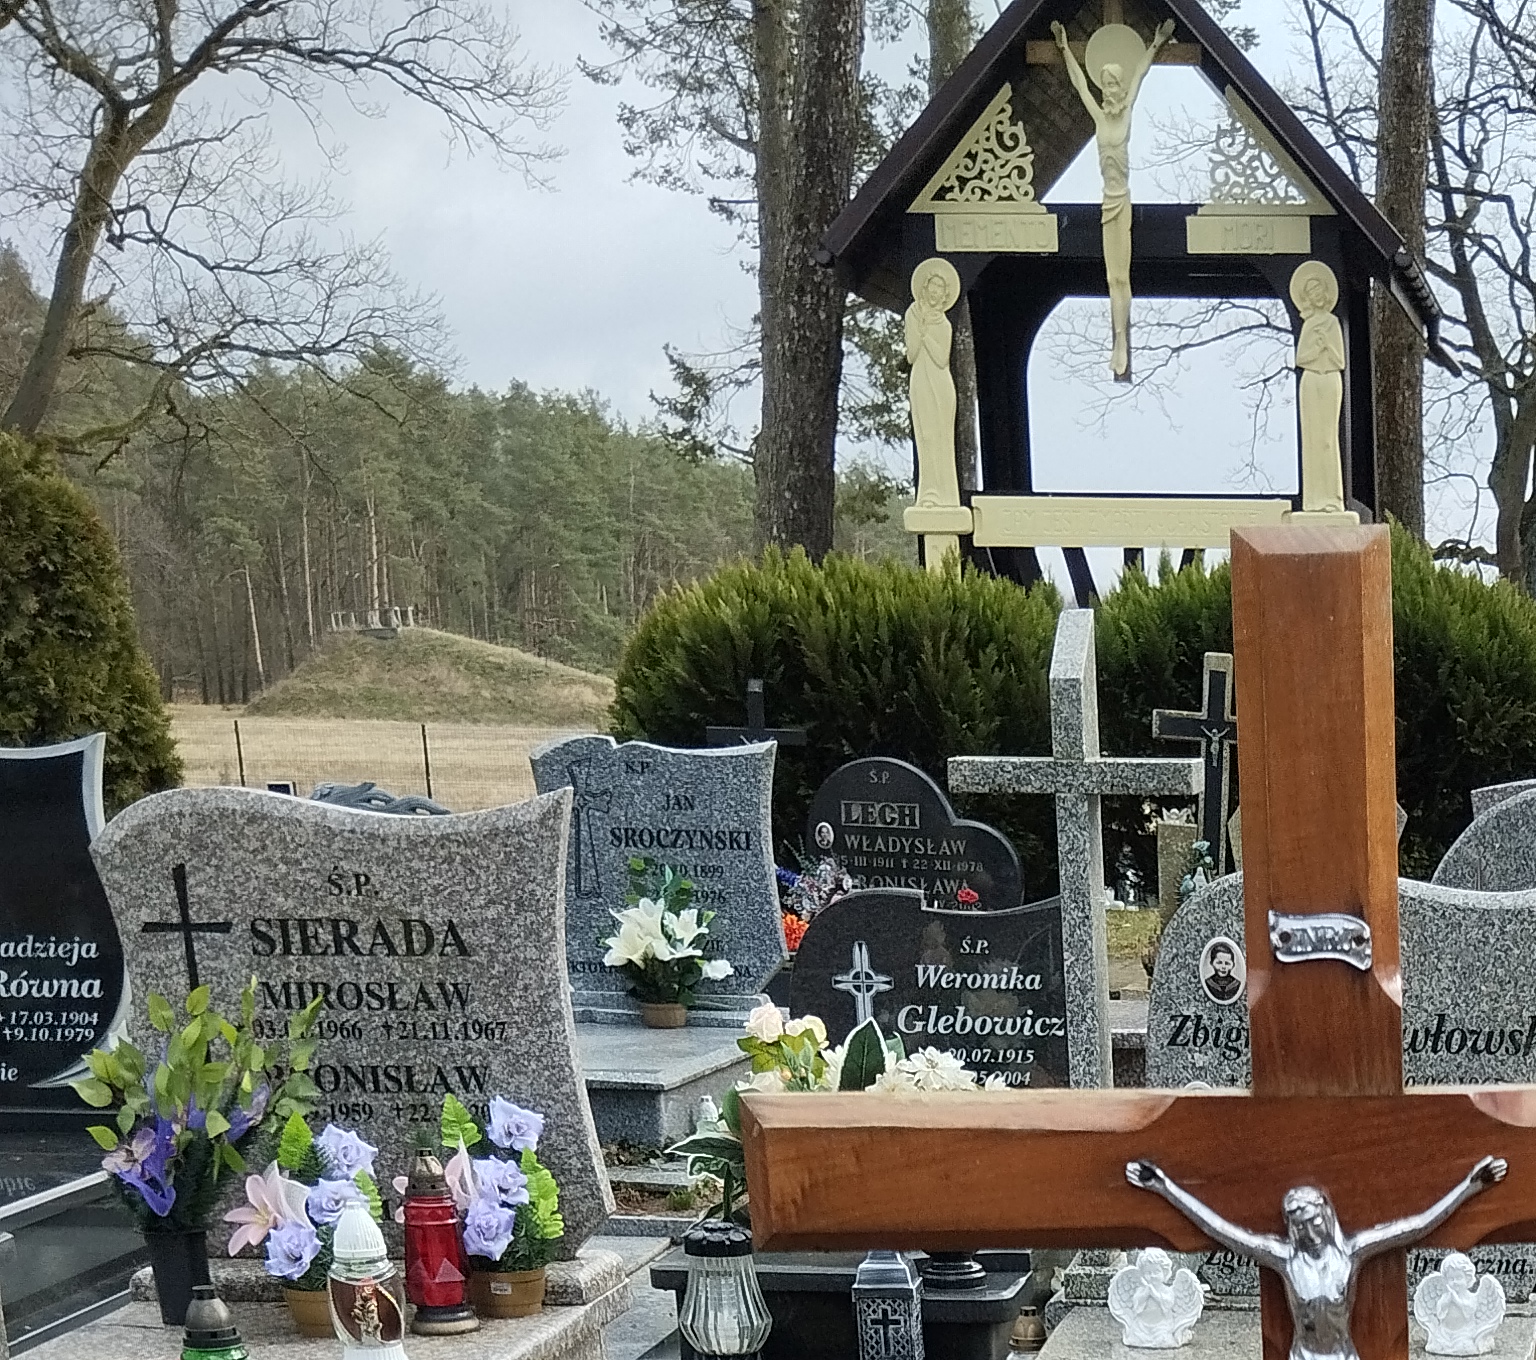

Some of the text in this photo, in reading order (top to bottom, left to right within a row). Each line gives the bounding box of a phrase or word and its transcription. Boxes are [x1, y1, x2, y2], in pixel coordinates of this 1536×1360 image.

[664, 794, 695, 811] JAN
[842, 801, 919, 828] LECH
[845, 834, 967, 856] WŁADYSŁAW
[327, 865, 380, 897] Ś.P.
[0, 935, 99, 966] adzieja
[250, 917, 472, 957] SIERADA
[960, 936, 989, 954] Ś.P.
[915, 964, 1042, 990] Weronika
[260, 981, 472, 1012] MIROSŁAW
[897, 1004, 1065, 1037] Glebowicz
